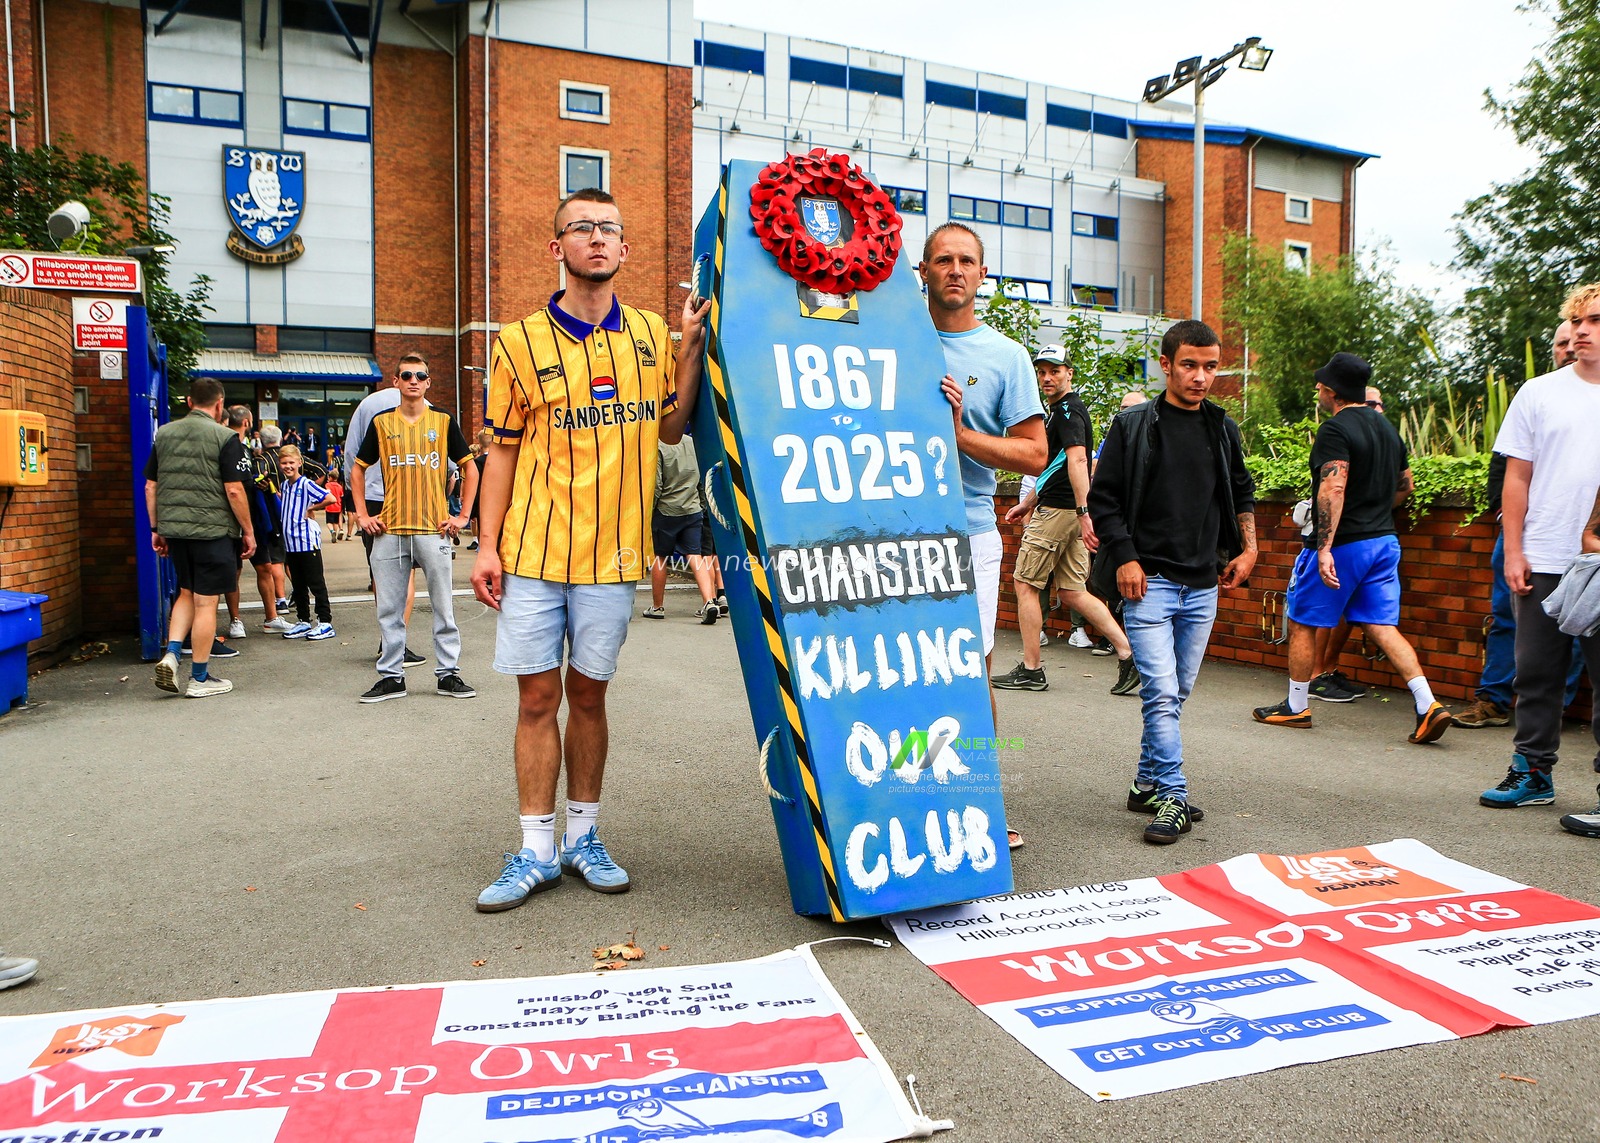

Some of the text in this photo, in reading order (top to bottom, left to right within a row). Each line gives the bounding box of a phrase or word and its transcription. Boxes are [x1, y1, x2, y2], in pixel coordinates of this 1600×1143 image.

[226, 148, 302, 172] S W
[36, 260, 125, 272] Hillsborough stadium
[36, 268, 45, 276] is
[54, 270, 66, 278] no
[67, 271, 103, 281] smoking
[104, 274, 130, 282] venue
[37, 276, 135, 288] thank you for your co-operation
[81, 325, 124, 335] No smoking
[81, 332, 124, 341] beyond this
[82, 340, 102, 348] point
[539, 372, 559, 382] PUMA
[772, 343, 898, 411] 1867
[553, 400, 657, 430] SANDERSON
[389, 450, 441, 471] ELEV8
[772, 431, 949, 504] 2025?
[777, 537, 968, 605] CHANSIRI
[794, 625, 983, 700] KILLING
[845, 715, 972, 788] OUR
[845, 805, 998, 895] CLUB
[1276, 855, 1360, 880] JUST
[1309, 866, 1401, 884] STOP
[904, 892, 1173, 934] Record Account Losses
[956, 908, 1162, 943] Hillsborough Sold
[1343, 900, 1522, 934] Owls
[680, 981, 734, 993] Sold
[1511, 978, 1594, 997] Points
[443, 1015, 590, 1034] Constantly
[756, 997, 818, 1008] Fans
[523, 1000, 620, 1017] Players
[1032, 990, 1168, 1019] DEJPHON
[1092, 1043, 1147, 1065] GET
[1153, 1036, 1203, 1053] OUT
[1209, 1025, 1244, 1045] OF
[1301, 1011, 1368, 1030] CLUB
[28, 1063, 440, 1119] Worksop
[500, 1087, 653, 1113] DEJPHON
